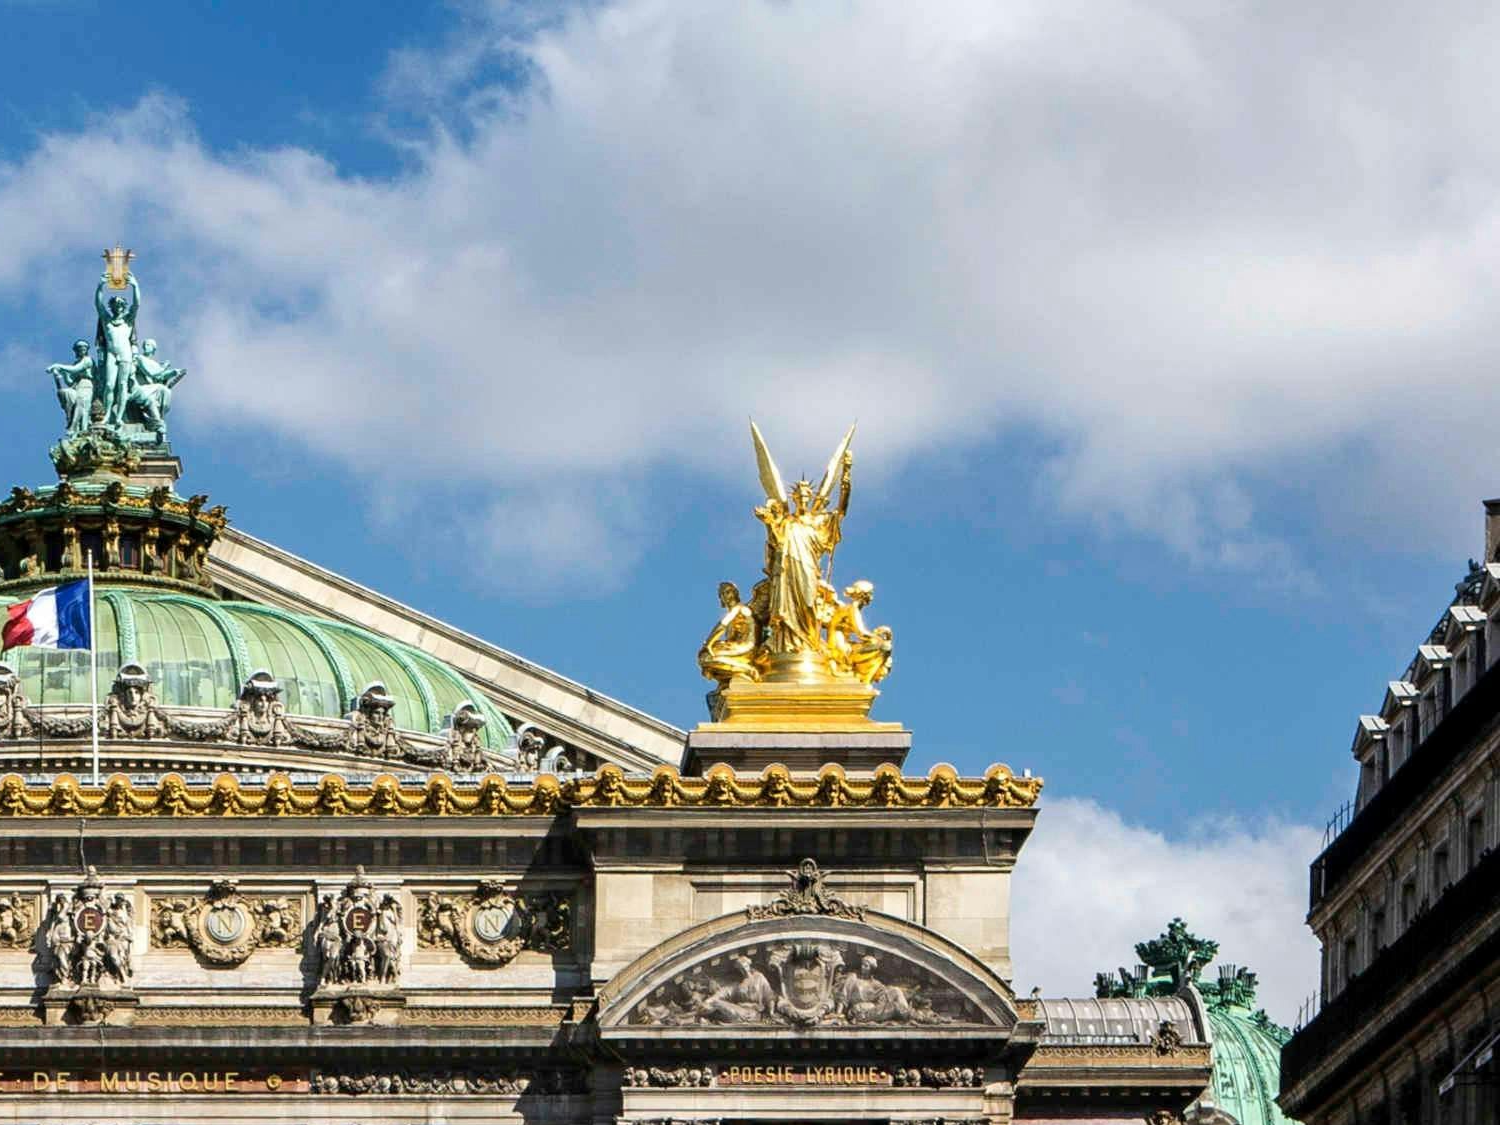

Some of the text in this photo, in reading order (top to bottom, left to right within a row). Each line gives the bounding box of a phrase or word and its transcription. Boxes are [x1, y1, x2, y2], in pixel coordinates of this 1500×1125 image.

[83, 913, 96, 929] E
[216, 914, 233, 934] N
[352, 912, 365, 929] E
[483, 914, 500, 933] N
[33, 1072, 71, 1092] DE
[100, 1072, 240, 1093] MUSIQUE
[730, 1066, 879, 1084] POESIE LYRIQUE
